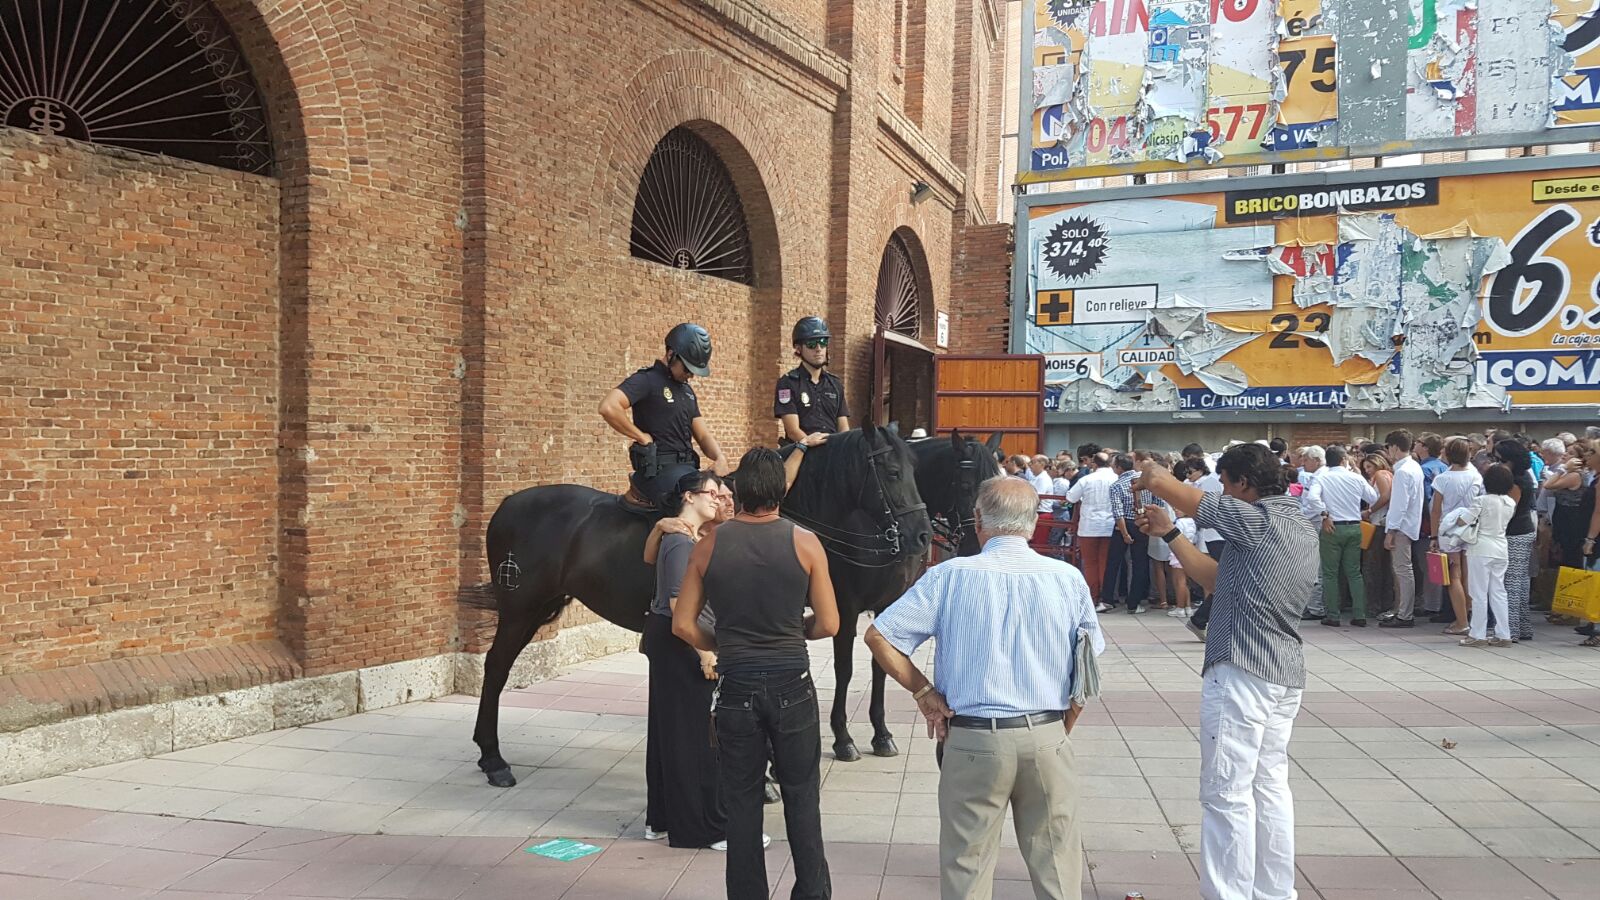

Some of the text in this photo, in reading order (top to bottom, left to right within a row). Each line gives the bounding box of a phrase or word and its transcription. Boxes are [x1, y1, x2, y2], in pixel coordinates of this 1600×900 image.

[1279, 47, 1337, 93] 75
[1041, 152, 1067, 167] Pol.
[1545, 184, 1587, 194] Desde
[1234, 182, 1426, 215] BRICOBOMBAZOS
[1061, 228, 1089, 239] SOLO
[1086, 298, 1147, 312] Con relieve
[1553, 334, 1565, 344] La
[1568, 333, 1590, 347] caja
[1121, 351, 1175, 363] CALIDAD
[1045, 357, 1088, 375] MOHS 6
[1200, 394, 1216, 407] C/
